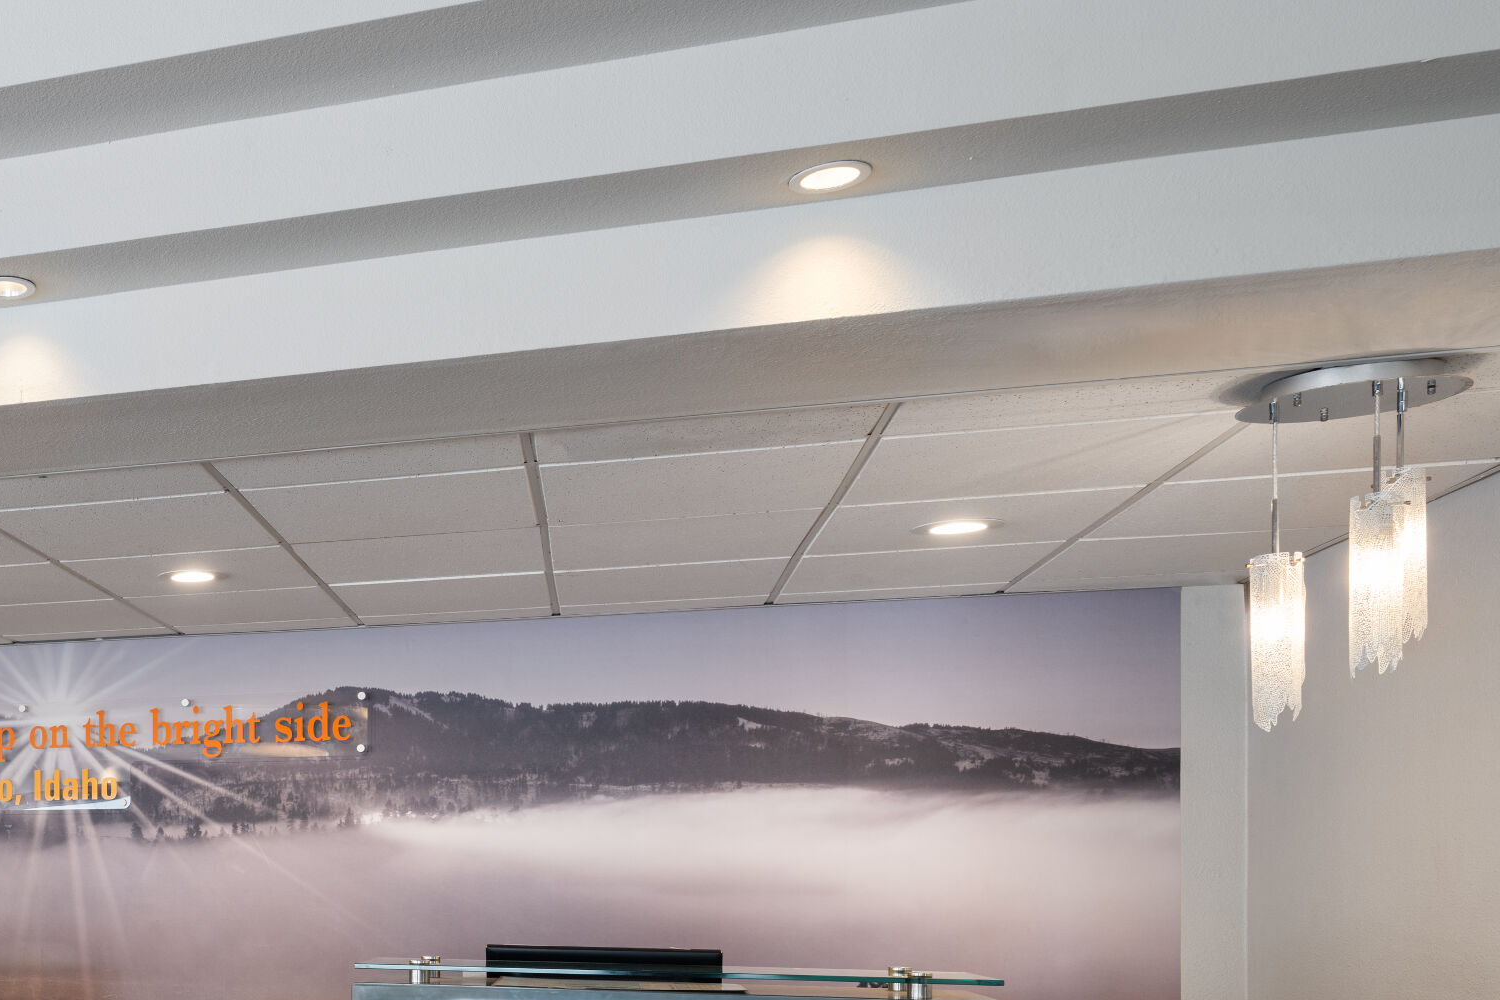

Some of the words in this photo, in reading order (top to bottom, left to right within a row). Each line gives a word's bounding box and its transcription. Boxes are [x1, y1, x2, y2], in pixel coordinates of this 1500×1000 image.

[29, 723, 70, 750] on
[82, 710, 137, 748] the
[149, 704, 261, 758] bright
[274, 701, 352, 743] side
[34, 768, 118, 801] Idaho
